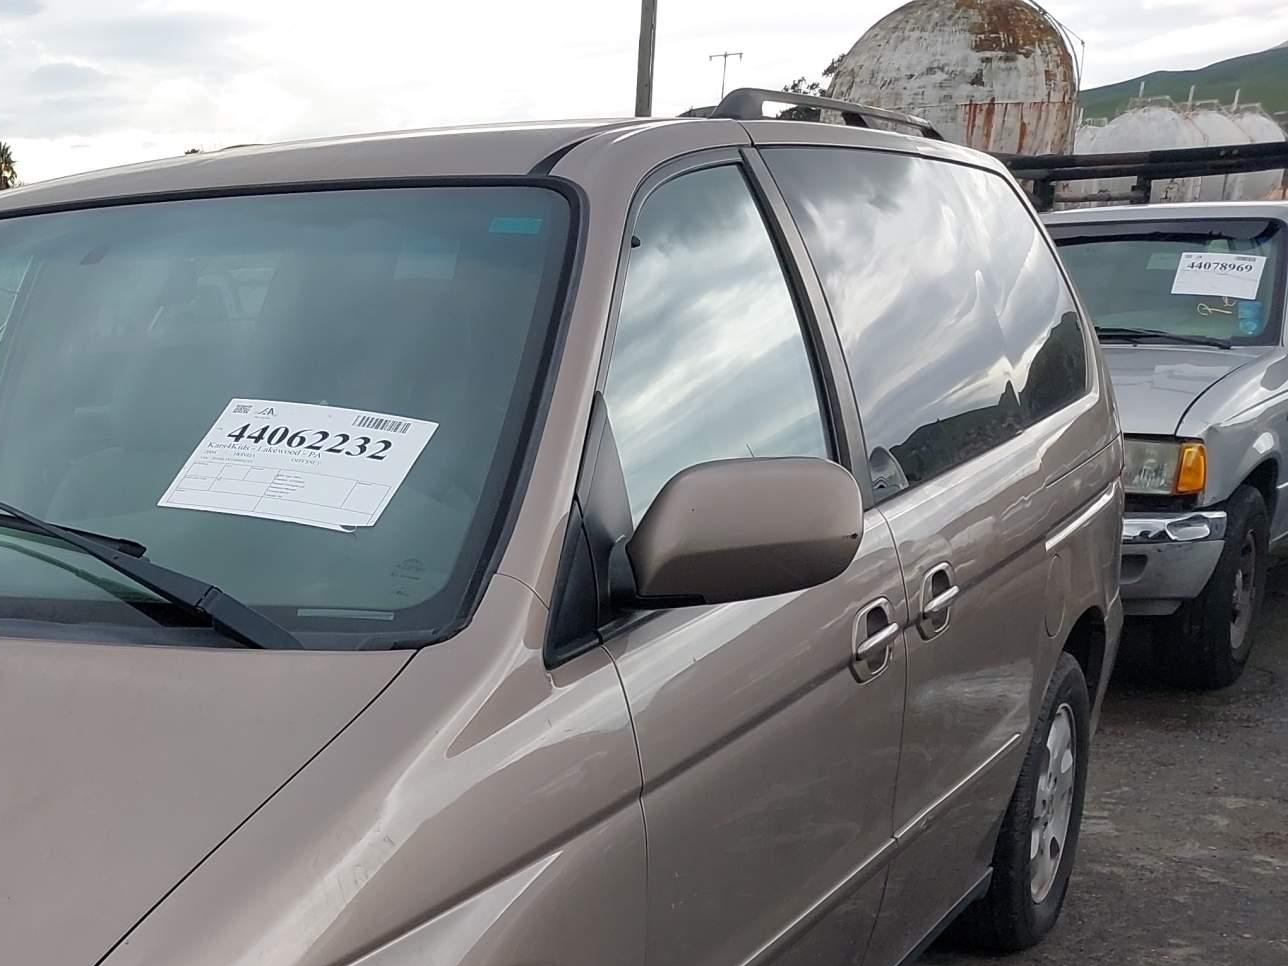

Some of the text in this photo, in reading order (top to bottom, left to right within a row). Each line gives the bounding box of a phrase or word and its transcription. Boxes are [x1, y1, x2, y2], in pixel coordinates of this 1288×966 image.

[1186, 261, 1253, 273] 44078969
[227, 422, 393, 462] 44062232
[308, 451, 321, 459] PA
